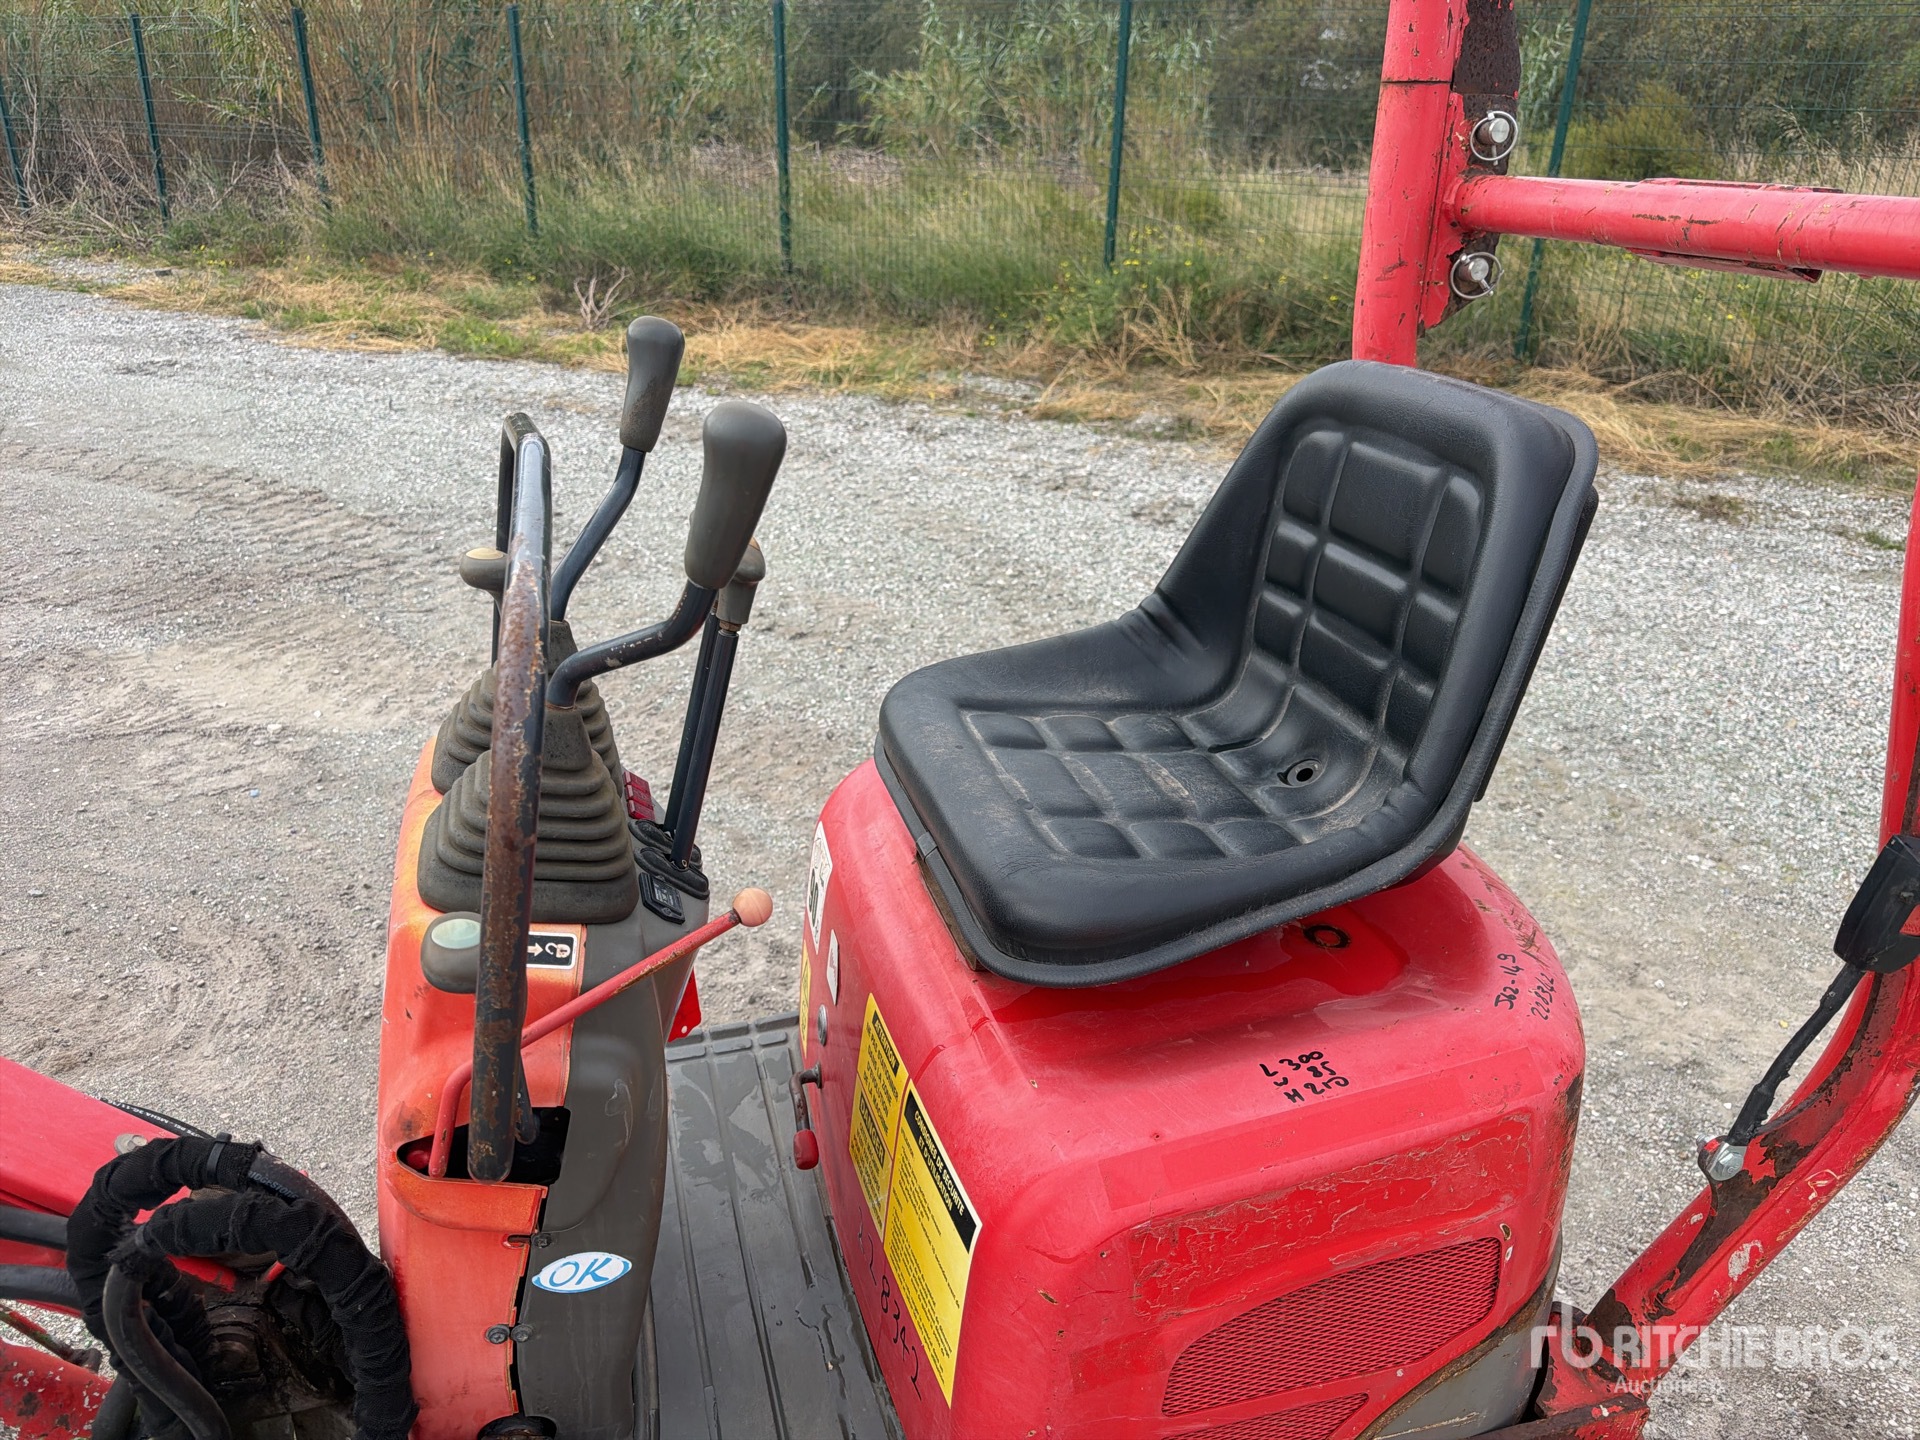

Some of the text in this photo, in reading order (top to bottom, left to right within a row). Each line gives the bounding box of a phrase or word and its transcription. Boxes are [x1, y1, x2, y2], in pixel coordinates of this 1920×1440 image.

[874, 1019, 897, 1069] ATTENTION
[1259, 1051, 1324, 1077] L 300
[1306, 1061, 1337, 1078] 85
[1283, 1088, 1305, 1103] H
[860, 1100, 884, 1165] DANGER
[914, 1110, 965, 1217] CONSIGNES DE SECURITE
[918, 1136, 953, 1211] ET D'UTILISATION
[247, 1169, 300, 1198] RIDGESTONE
[548, 1257, 613, 1287] OK
